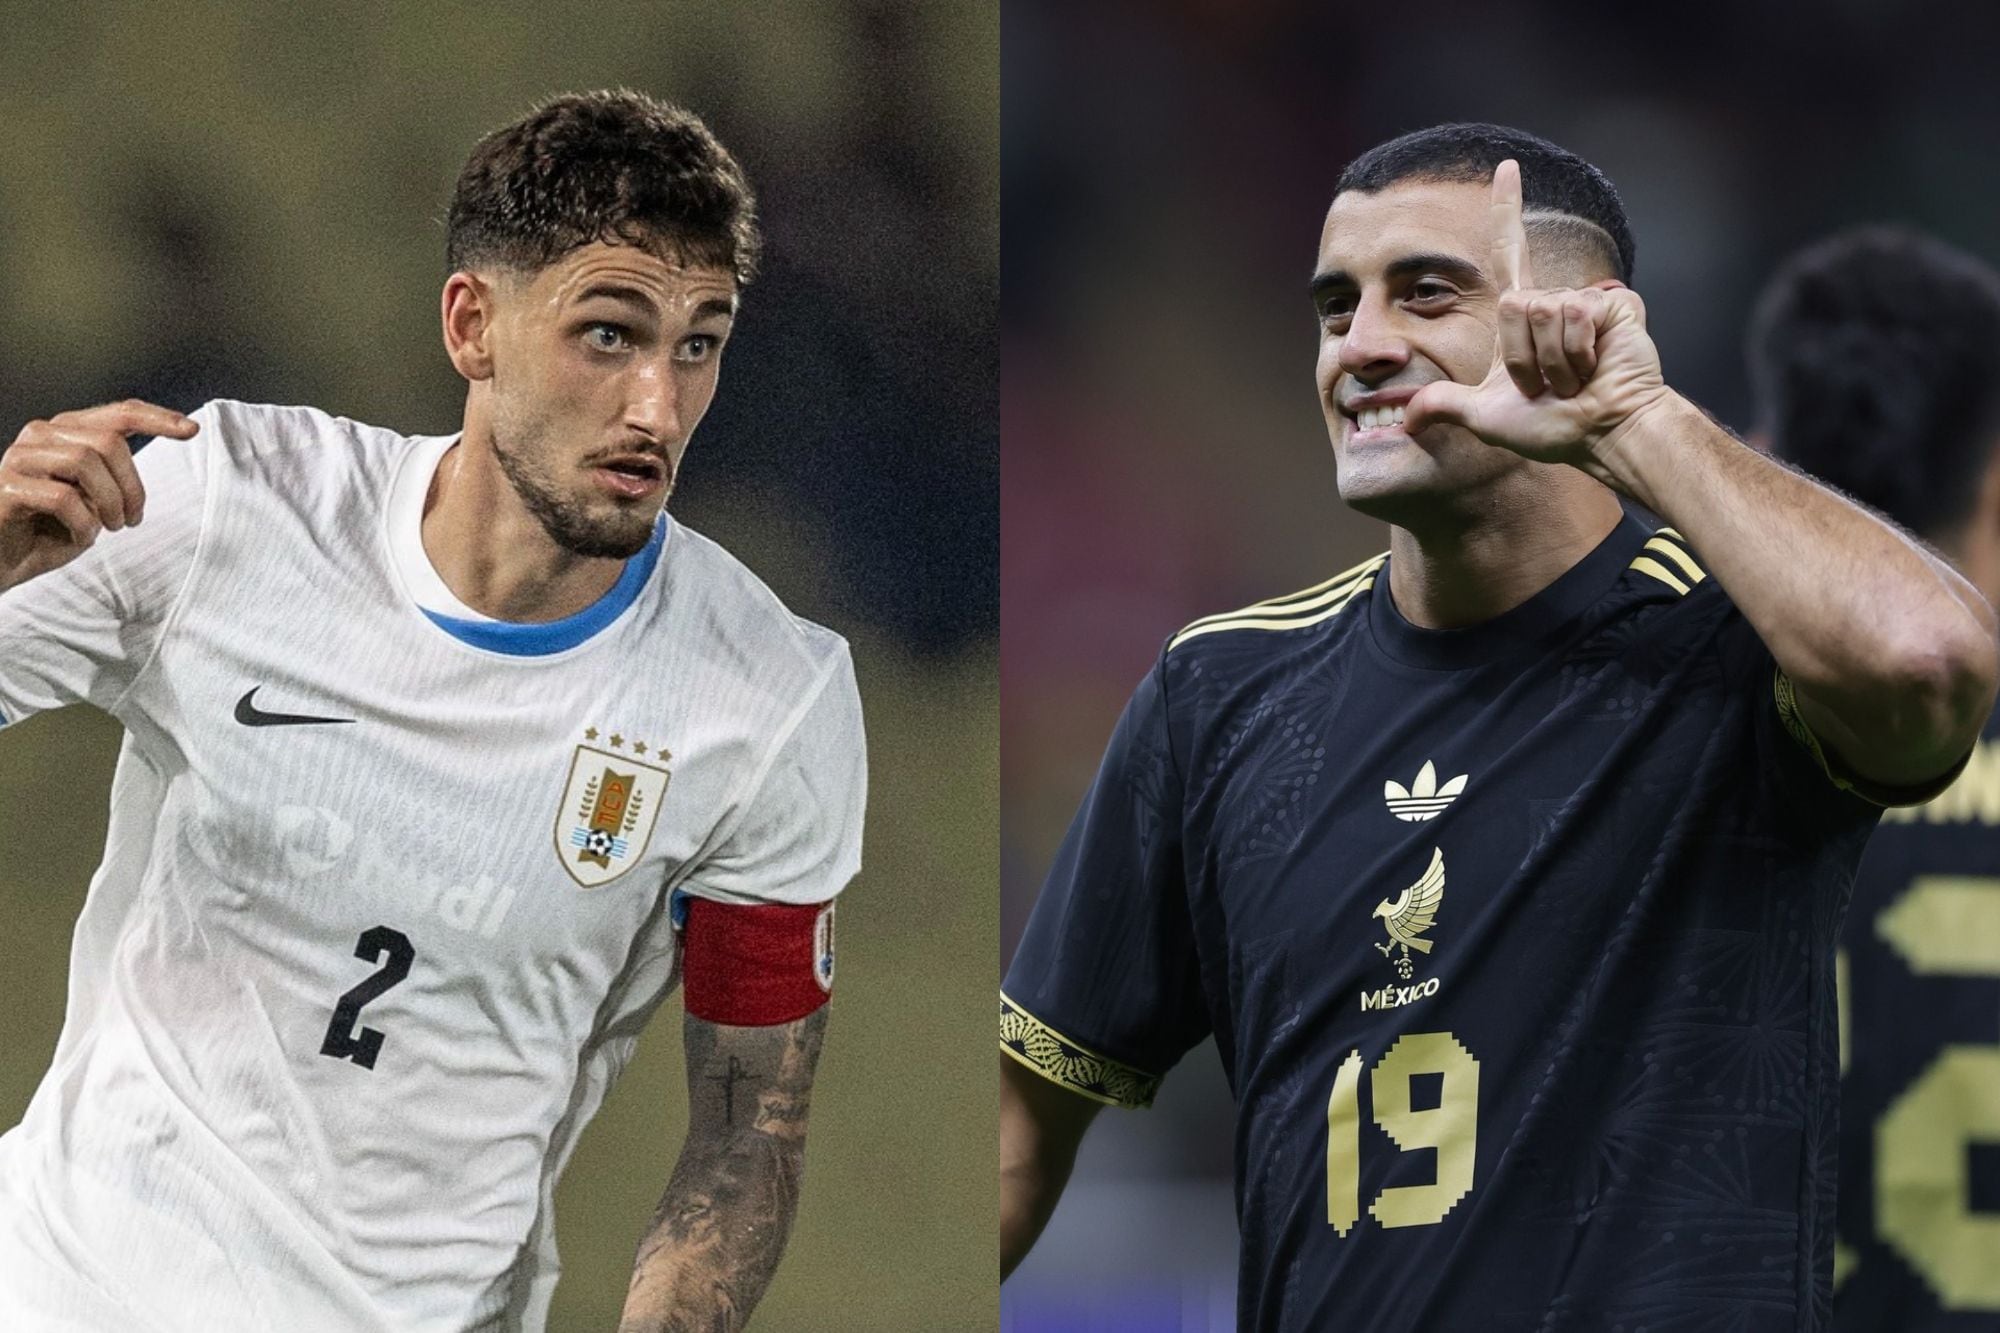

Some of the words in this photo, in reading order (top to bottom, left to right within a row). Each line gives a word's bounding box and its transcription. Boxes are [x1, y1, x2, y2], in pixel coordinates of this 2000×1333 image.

[319, 925, 416, 1071] 2
[1360, 977, 1440, 1012] MÉXICO
[1326, 1032, 1481, 1238] 19
